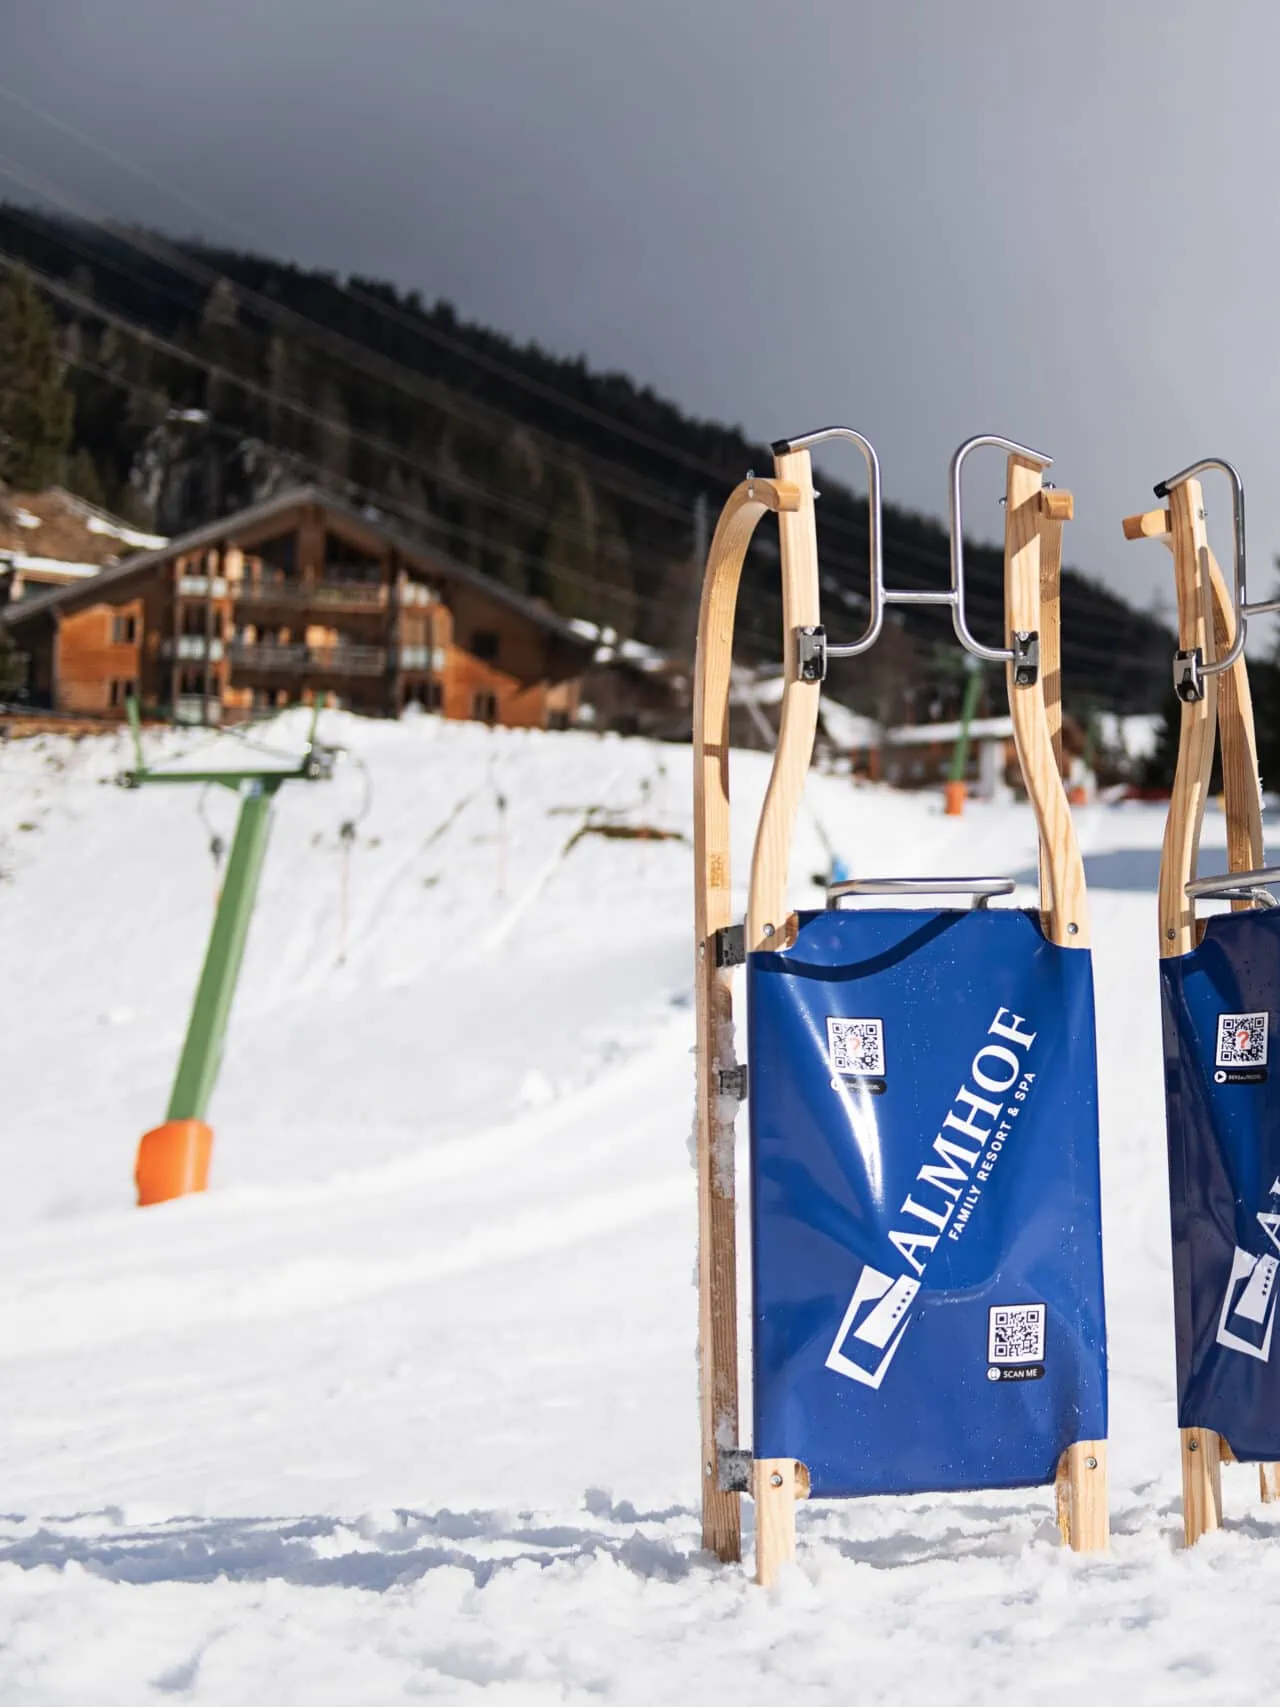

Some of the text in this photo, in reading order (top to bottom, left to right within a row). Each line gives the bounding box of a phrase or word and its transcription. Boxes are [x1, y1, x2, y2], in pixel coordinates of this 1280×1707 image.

[888, 1007, 1037, 1276] ALMHOF
[948, 1071, 1036, 1240] FAMILY RESORT & SPA
[1003, 1368, 1037, 1378] SCAN ME
